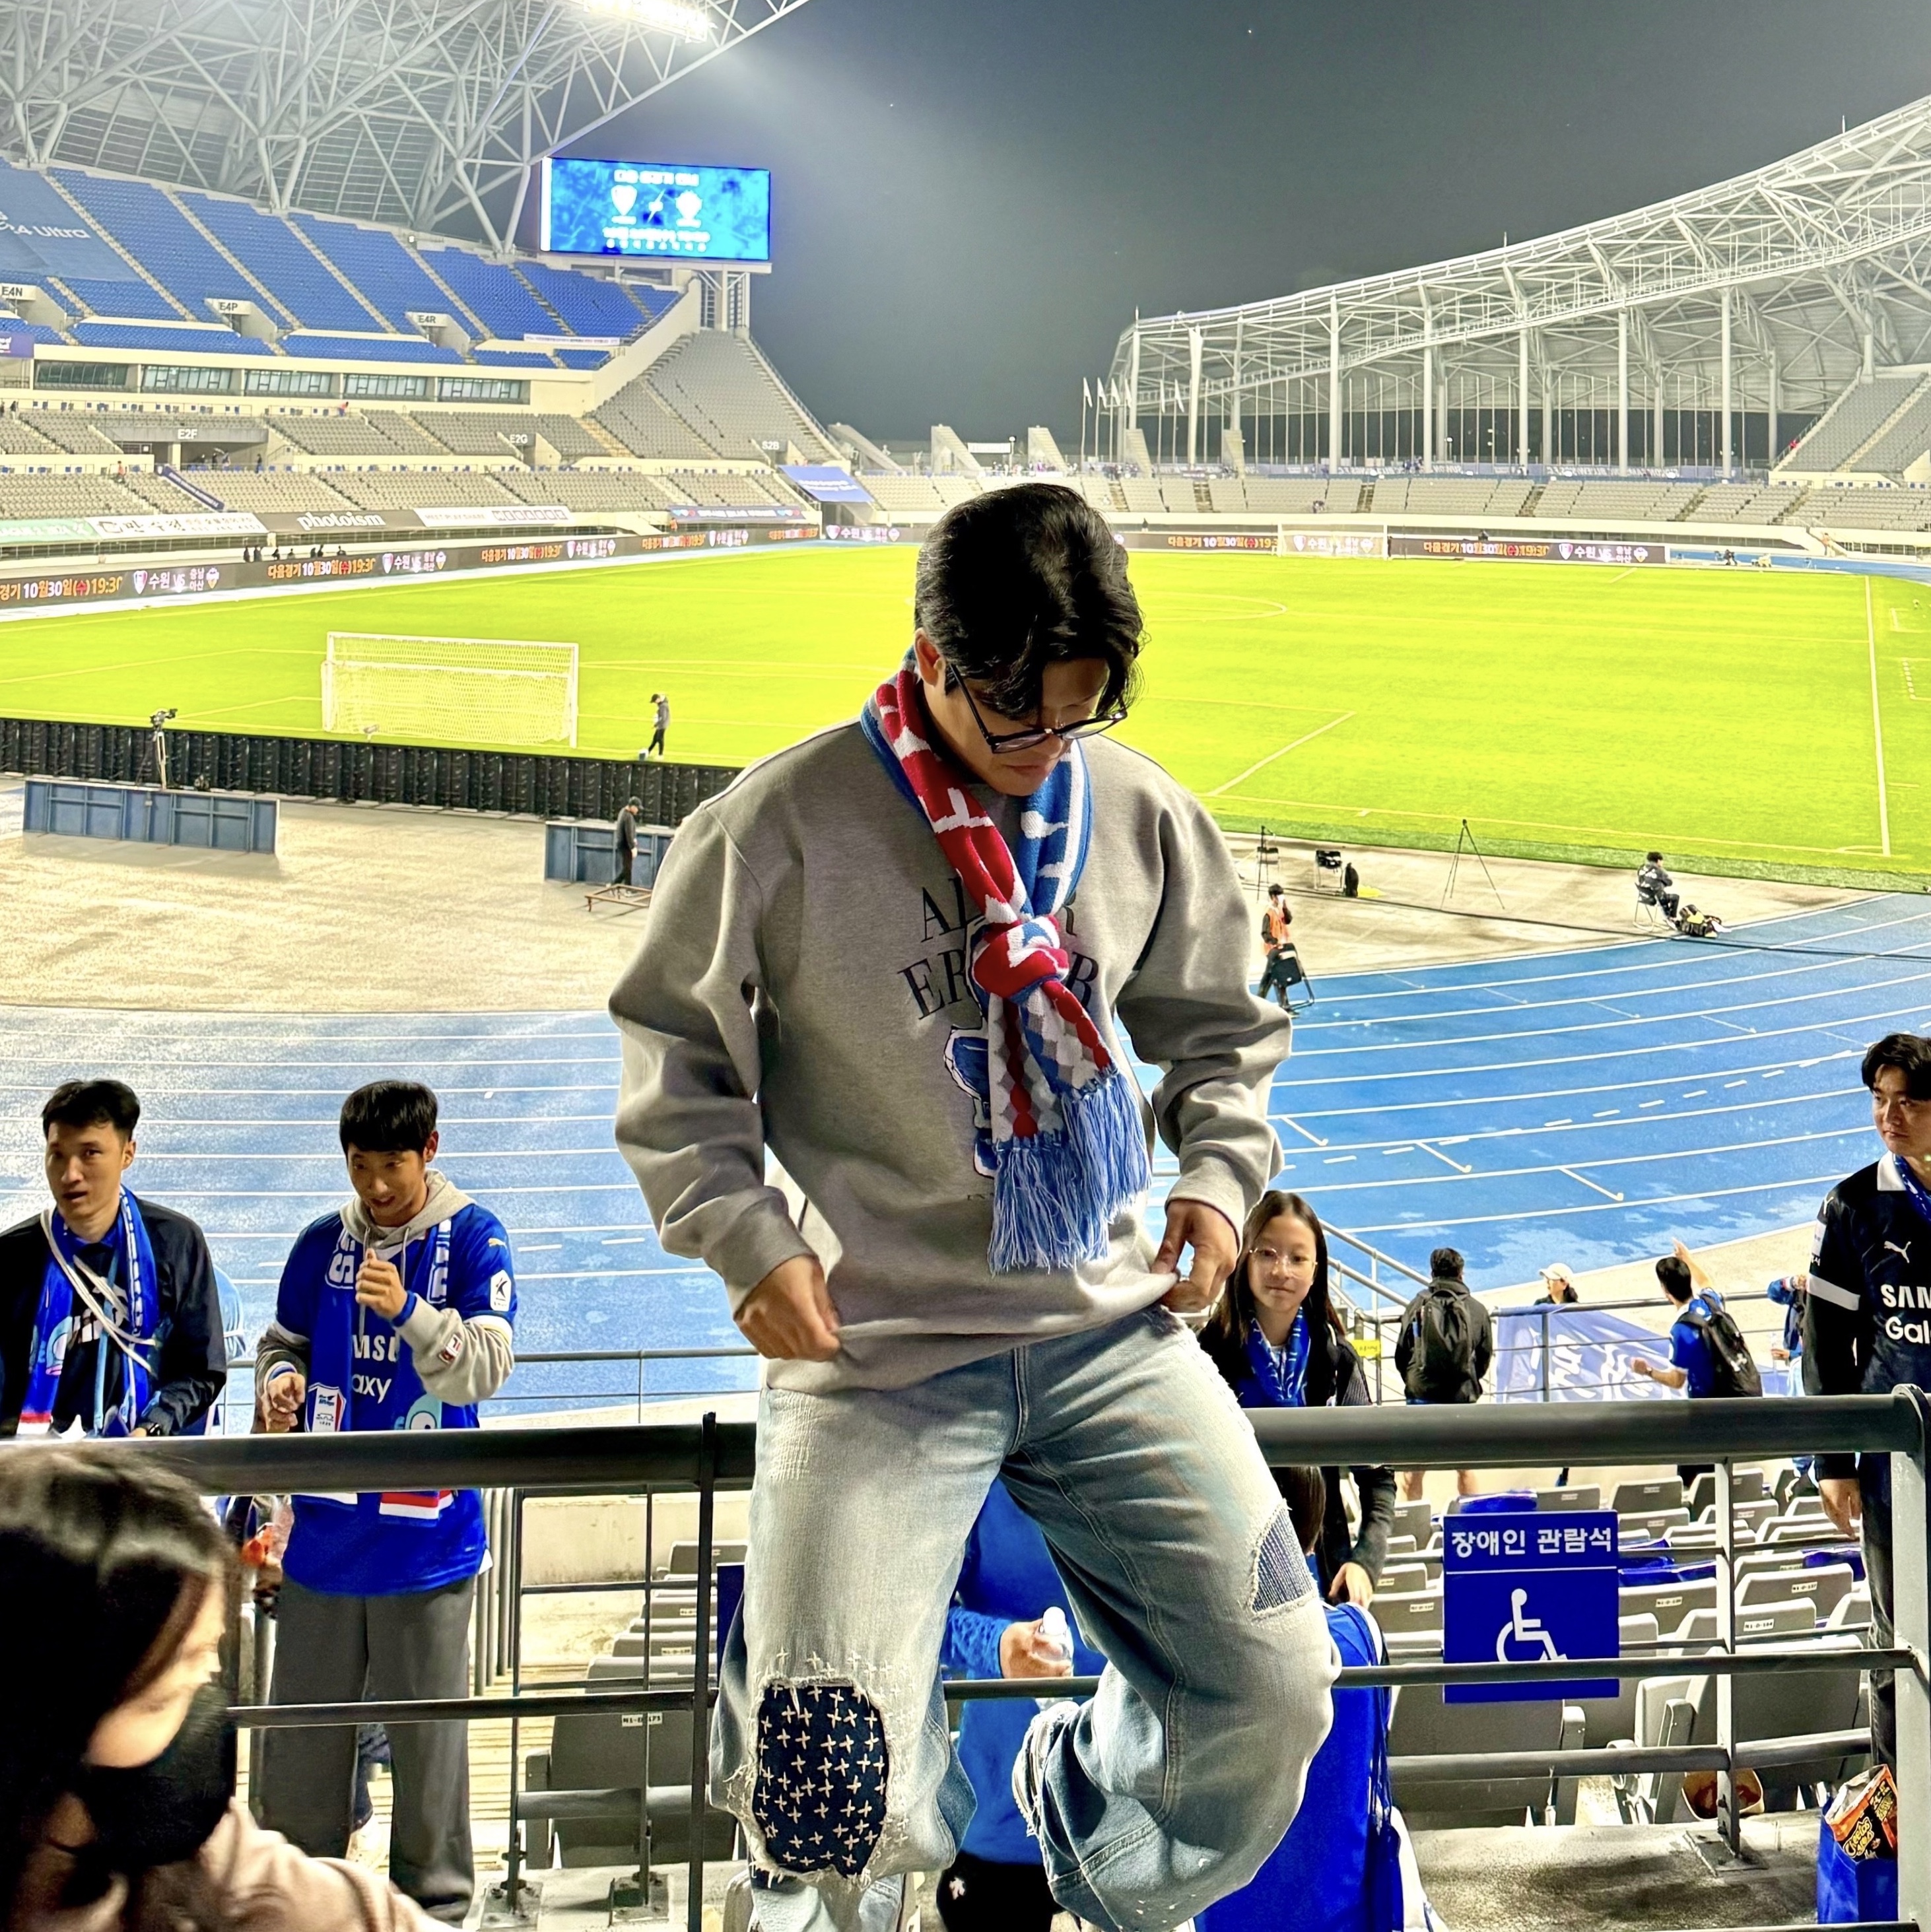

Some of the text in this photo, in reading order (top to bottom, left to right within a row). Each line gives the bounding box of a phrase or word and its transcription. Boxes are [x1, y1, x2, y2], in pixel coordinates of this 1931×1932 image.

[33, 226, 91, 238] Ultra
[2, 286, 22, 296] E4N
[219, 302, 238, 312] E4P
[419, 315, 436, 324] E4R
[178, 428, 197, 440] E2F
[510, 434, 527, 444] E2G
[297, 512, 386, 531] photoism
[148, 571, 170, 591] 수원
[1452, 1527, 1611, 1558] 장애인 관람석
